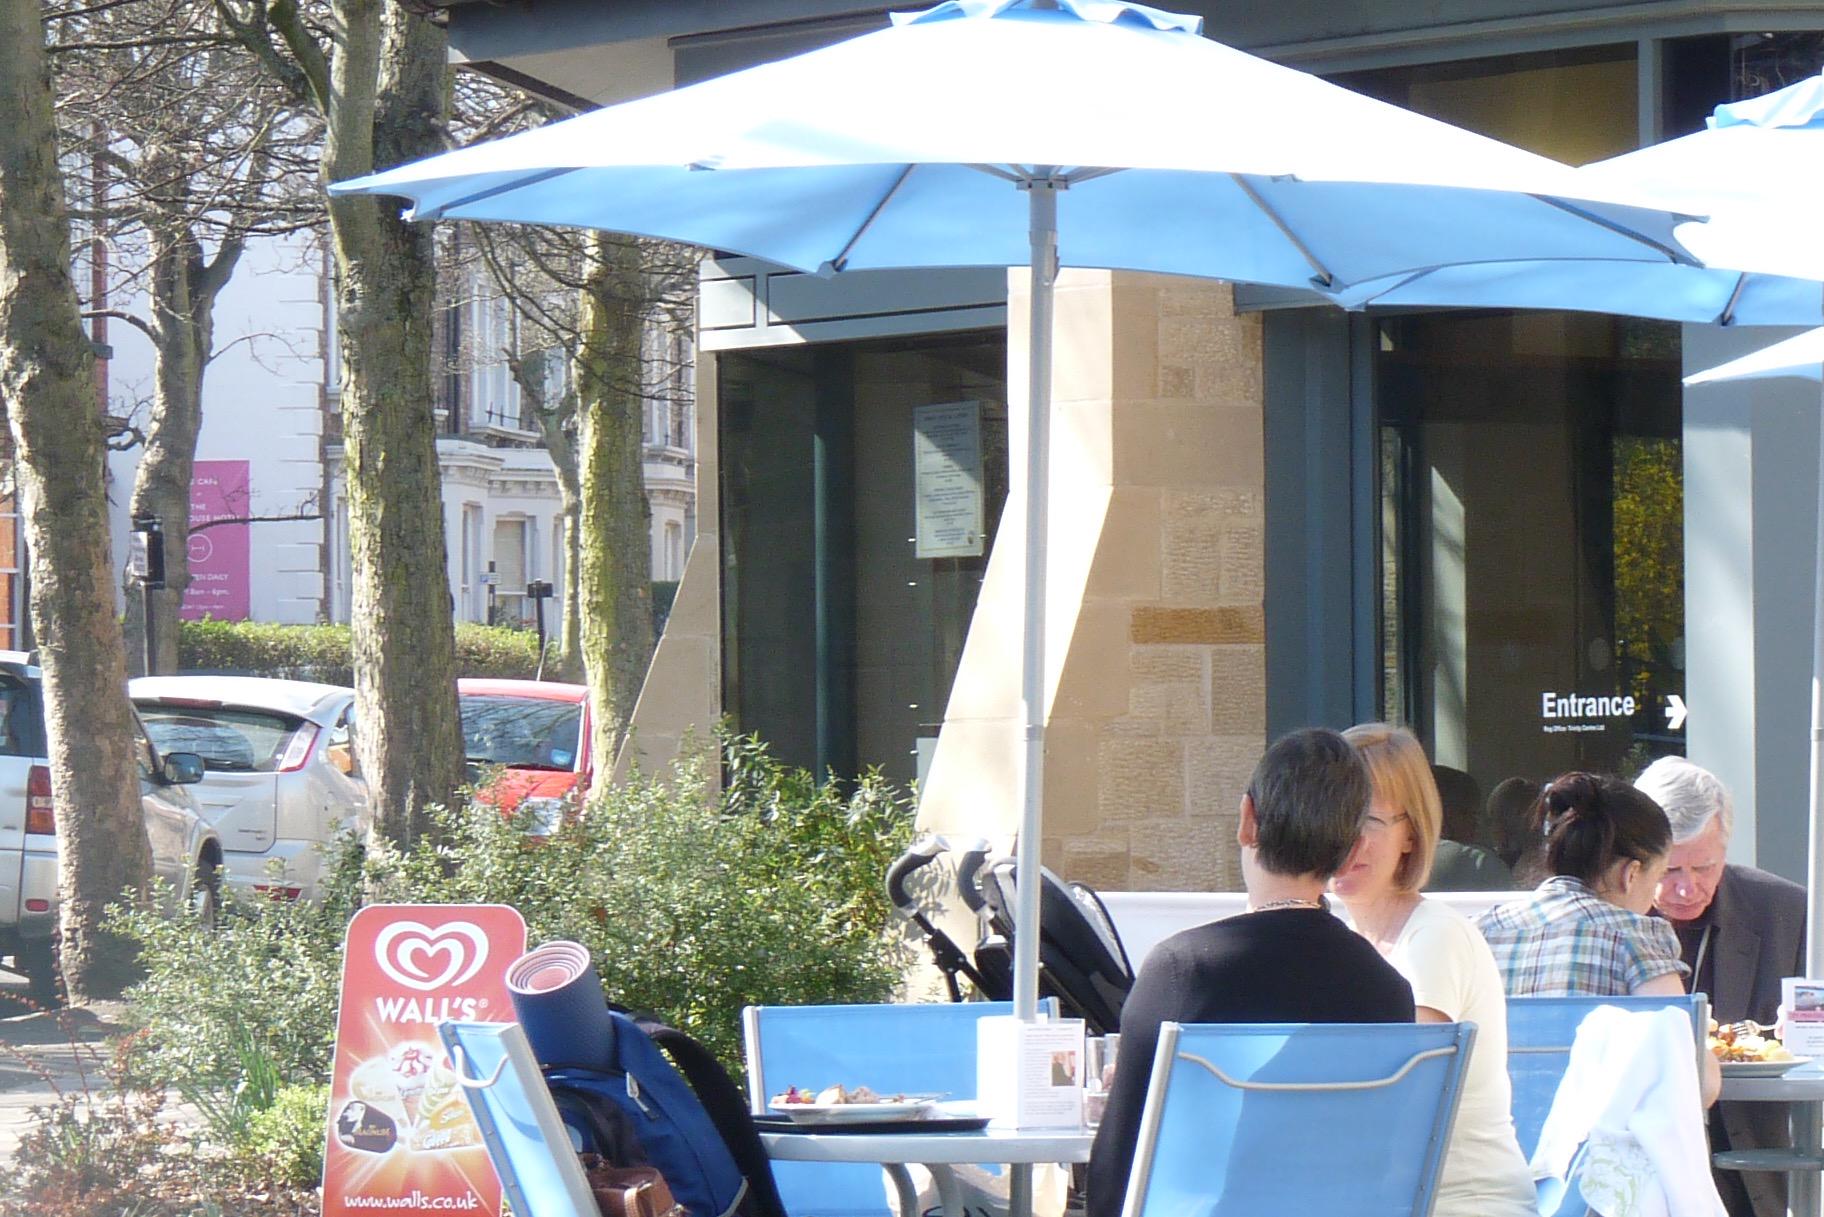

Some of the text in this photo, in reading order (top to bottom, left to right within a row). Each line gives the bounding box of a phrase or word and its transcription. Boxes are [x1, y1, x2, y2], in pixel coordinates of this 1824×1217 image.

[1542, 692, 1635, 718] Entrance
[375, 996, 477, 1024] WALL'S
[344, 1189, 478, 1210] www.walls.co.uk
